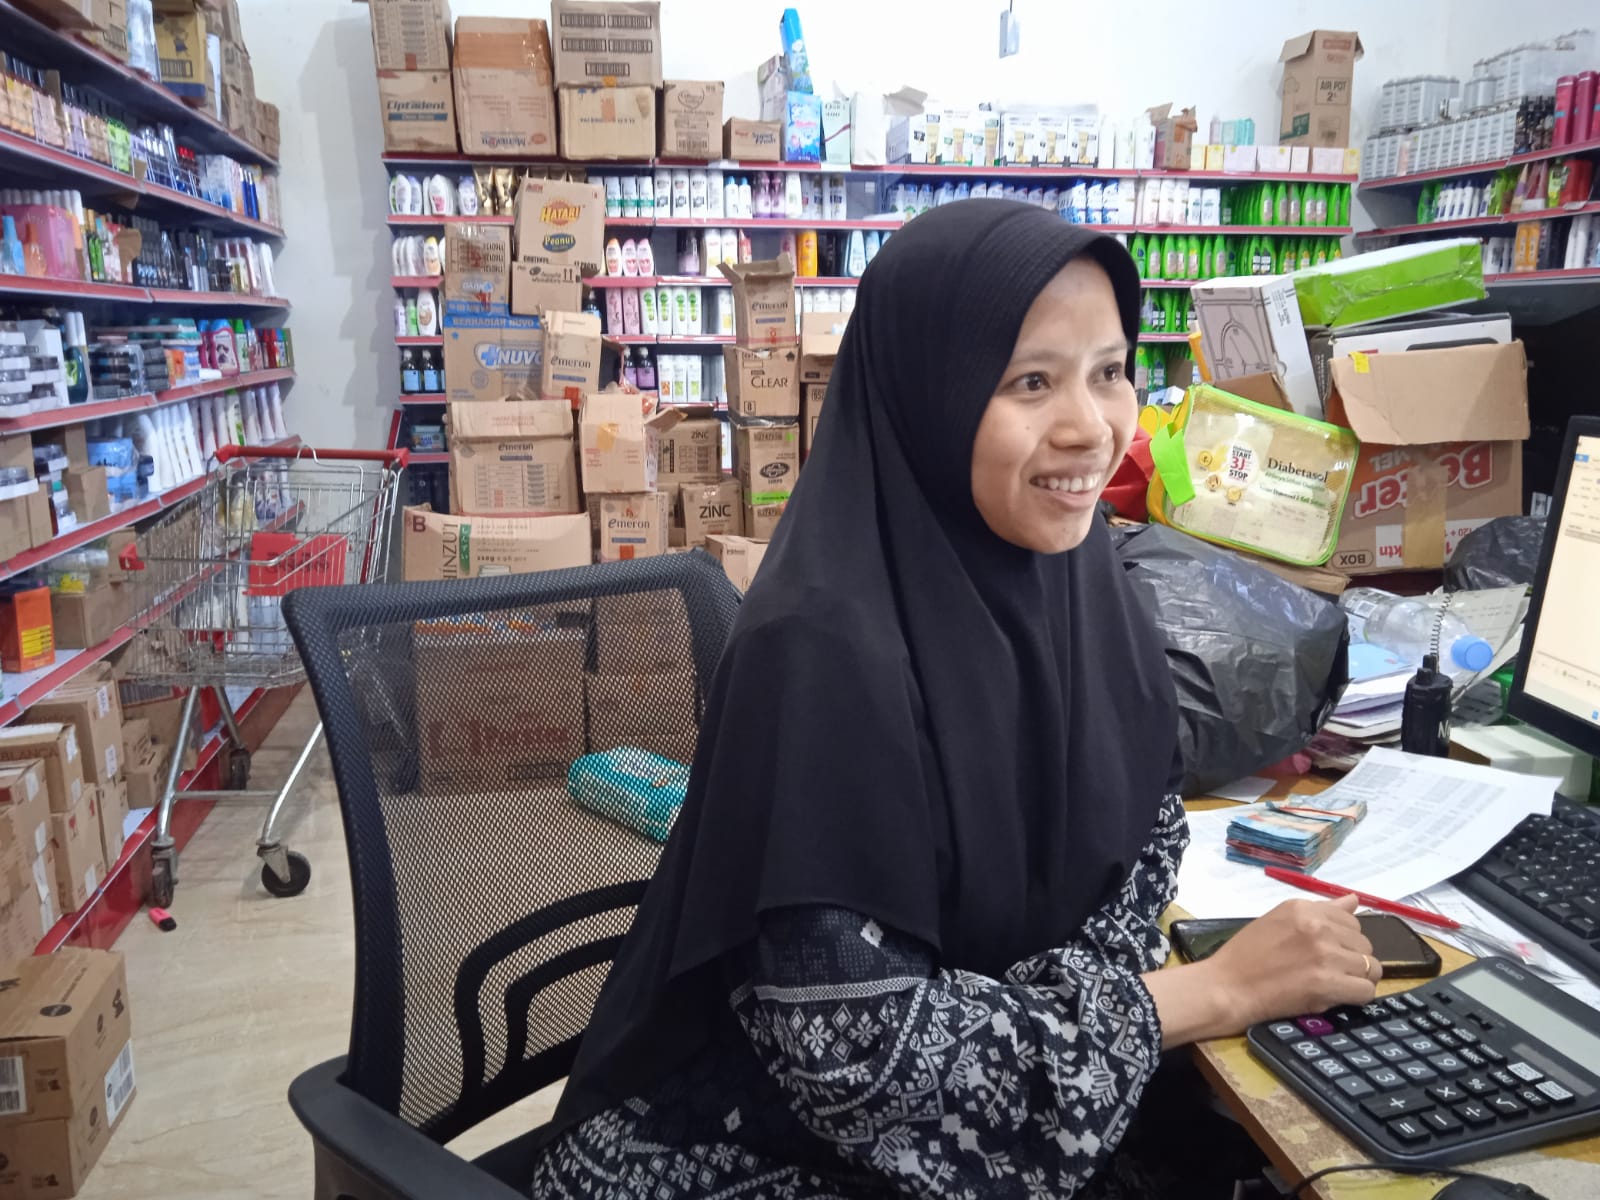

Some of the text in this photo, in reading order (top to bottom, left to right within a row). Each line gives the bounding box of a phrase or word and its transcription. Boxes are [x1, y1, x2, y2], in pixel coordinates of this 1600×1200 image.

[540, 205, 581, 223] HATARI
[544, 235, 574, 247] Peanut
[550, 355, 591, 369] emeron
[750, 376, 788, 388] CLEAR
[498, 442, 534, 452] emeron
[1229, 469, 1249, 481] STOP
[1267, 457, 1329, 484] Diabetasol
[1355, 441, 1493, 518] Beer
[412, 515, 426, 533] B
[608, 517, 650, 530] emeron
[1339, 553, 1367, 566] BOX
[1305, 1018, 1323, 1028] C
[1388, 1023, 1409, 1033] 7
[1276, 1024, 1294, 1034] 0
[1360, 1030, 1379, 1041] 4
[1331, 1037, 1348, 1046] 1
[1412, 1040, 1432, 1050] 8
[1297, 1041, 1321, 1057] 00
[1382, 1047, 1403, 1057] 5
[1351, 1055, 1372, 1065] 2
[1437, 1057, 1457, 1067] 9
[1317, 1057, 1345, 1075] 000
[1407, 1065, 1427, 1076] 6
[1375, 1072, 1396, 1083] 3
